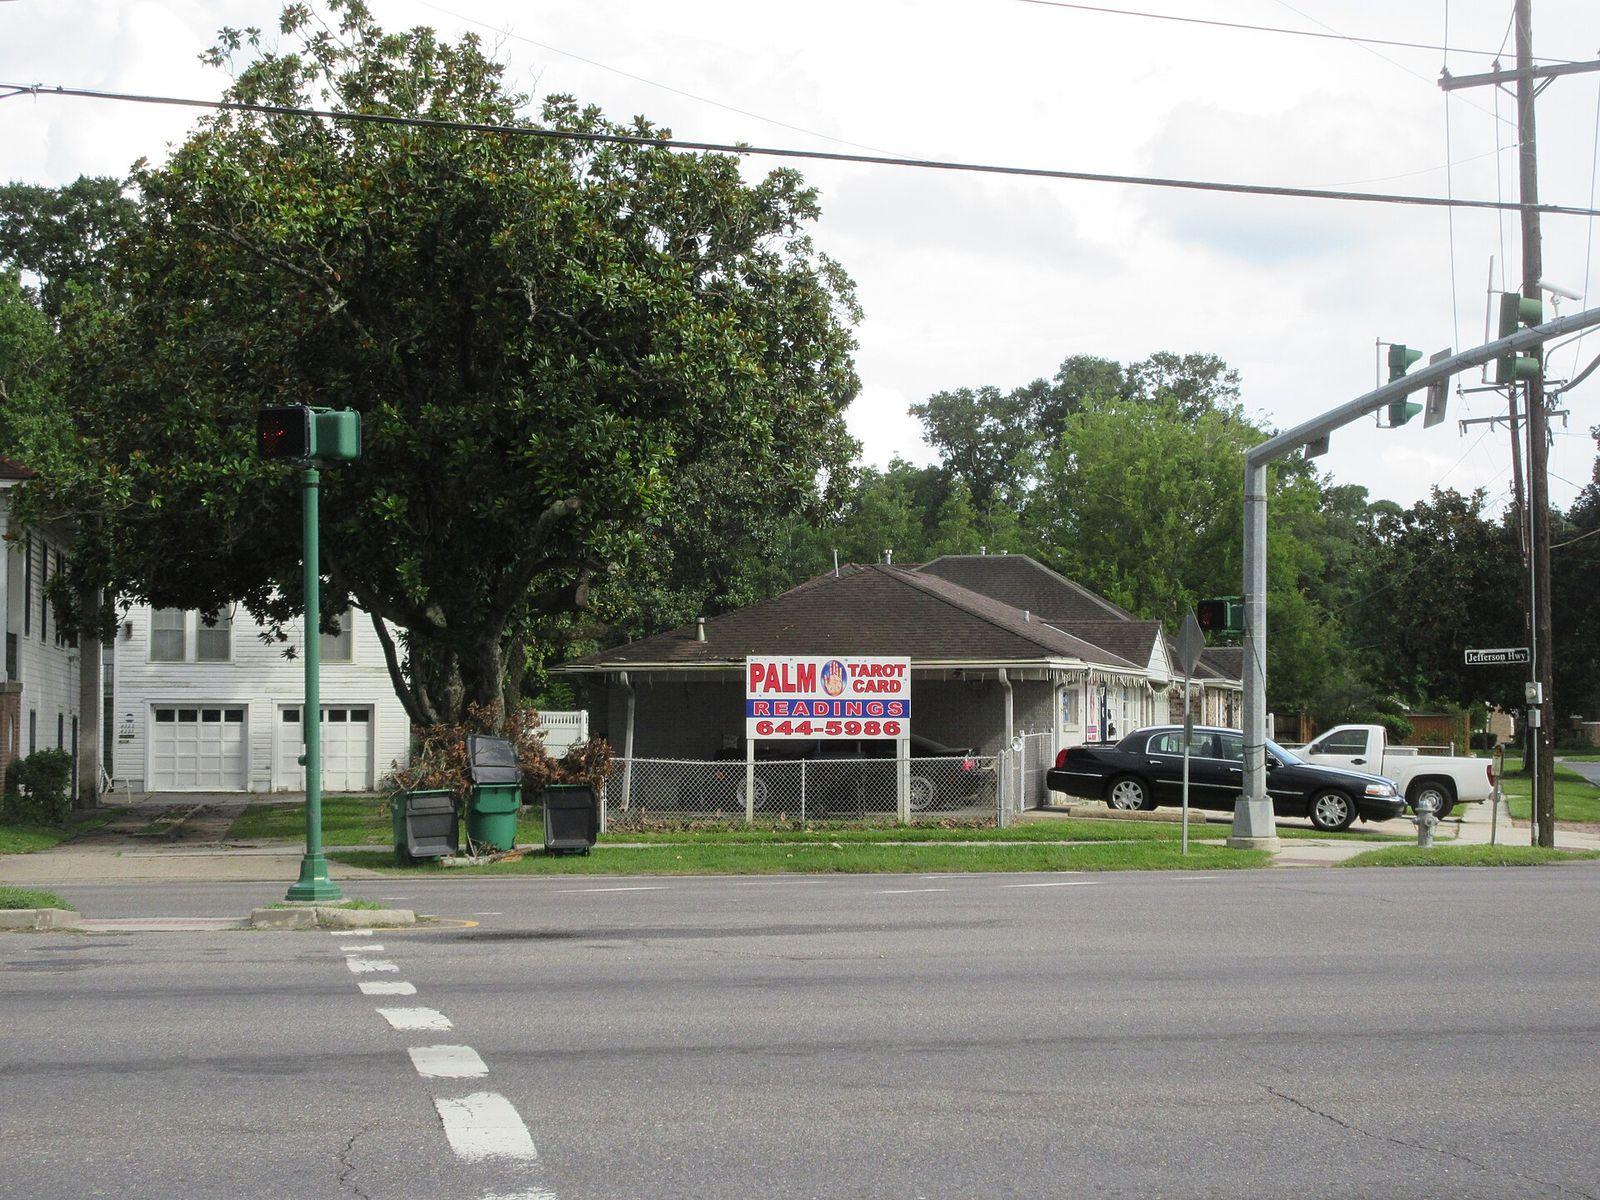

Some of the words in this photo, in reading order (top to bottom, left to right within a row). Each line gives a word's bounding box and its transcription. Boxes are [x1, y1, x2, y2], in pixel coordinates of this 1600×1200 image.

[1468, 652, 1506, 662] Jefferson
[1508, 651, 1526, 660] Hwy
[848, 664, 906, 677] TAROT
[750, 663, 816, 693] PALM
[852, 679, 902, 693] CARD
[753, 701, 903, 716] READINGS
[756, 720, 901, 735] 644-5986
